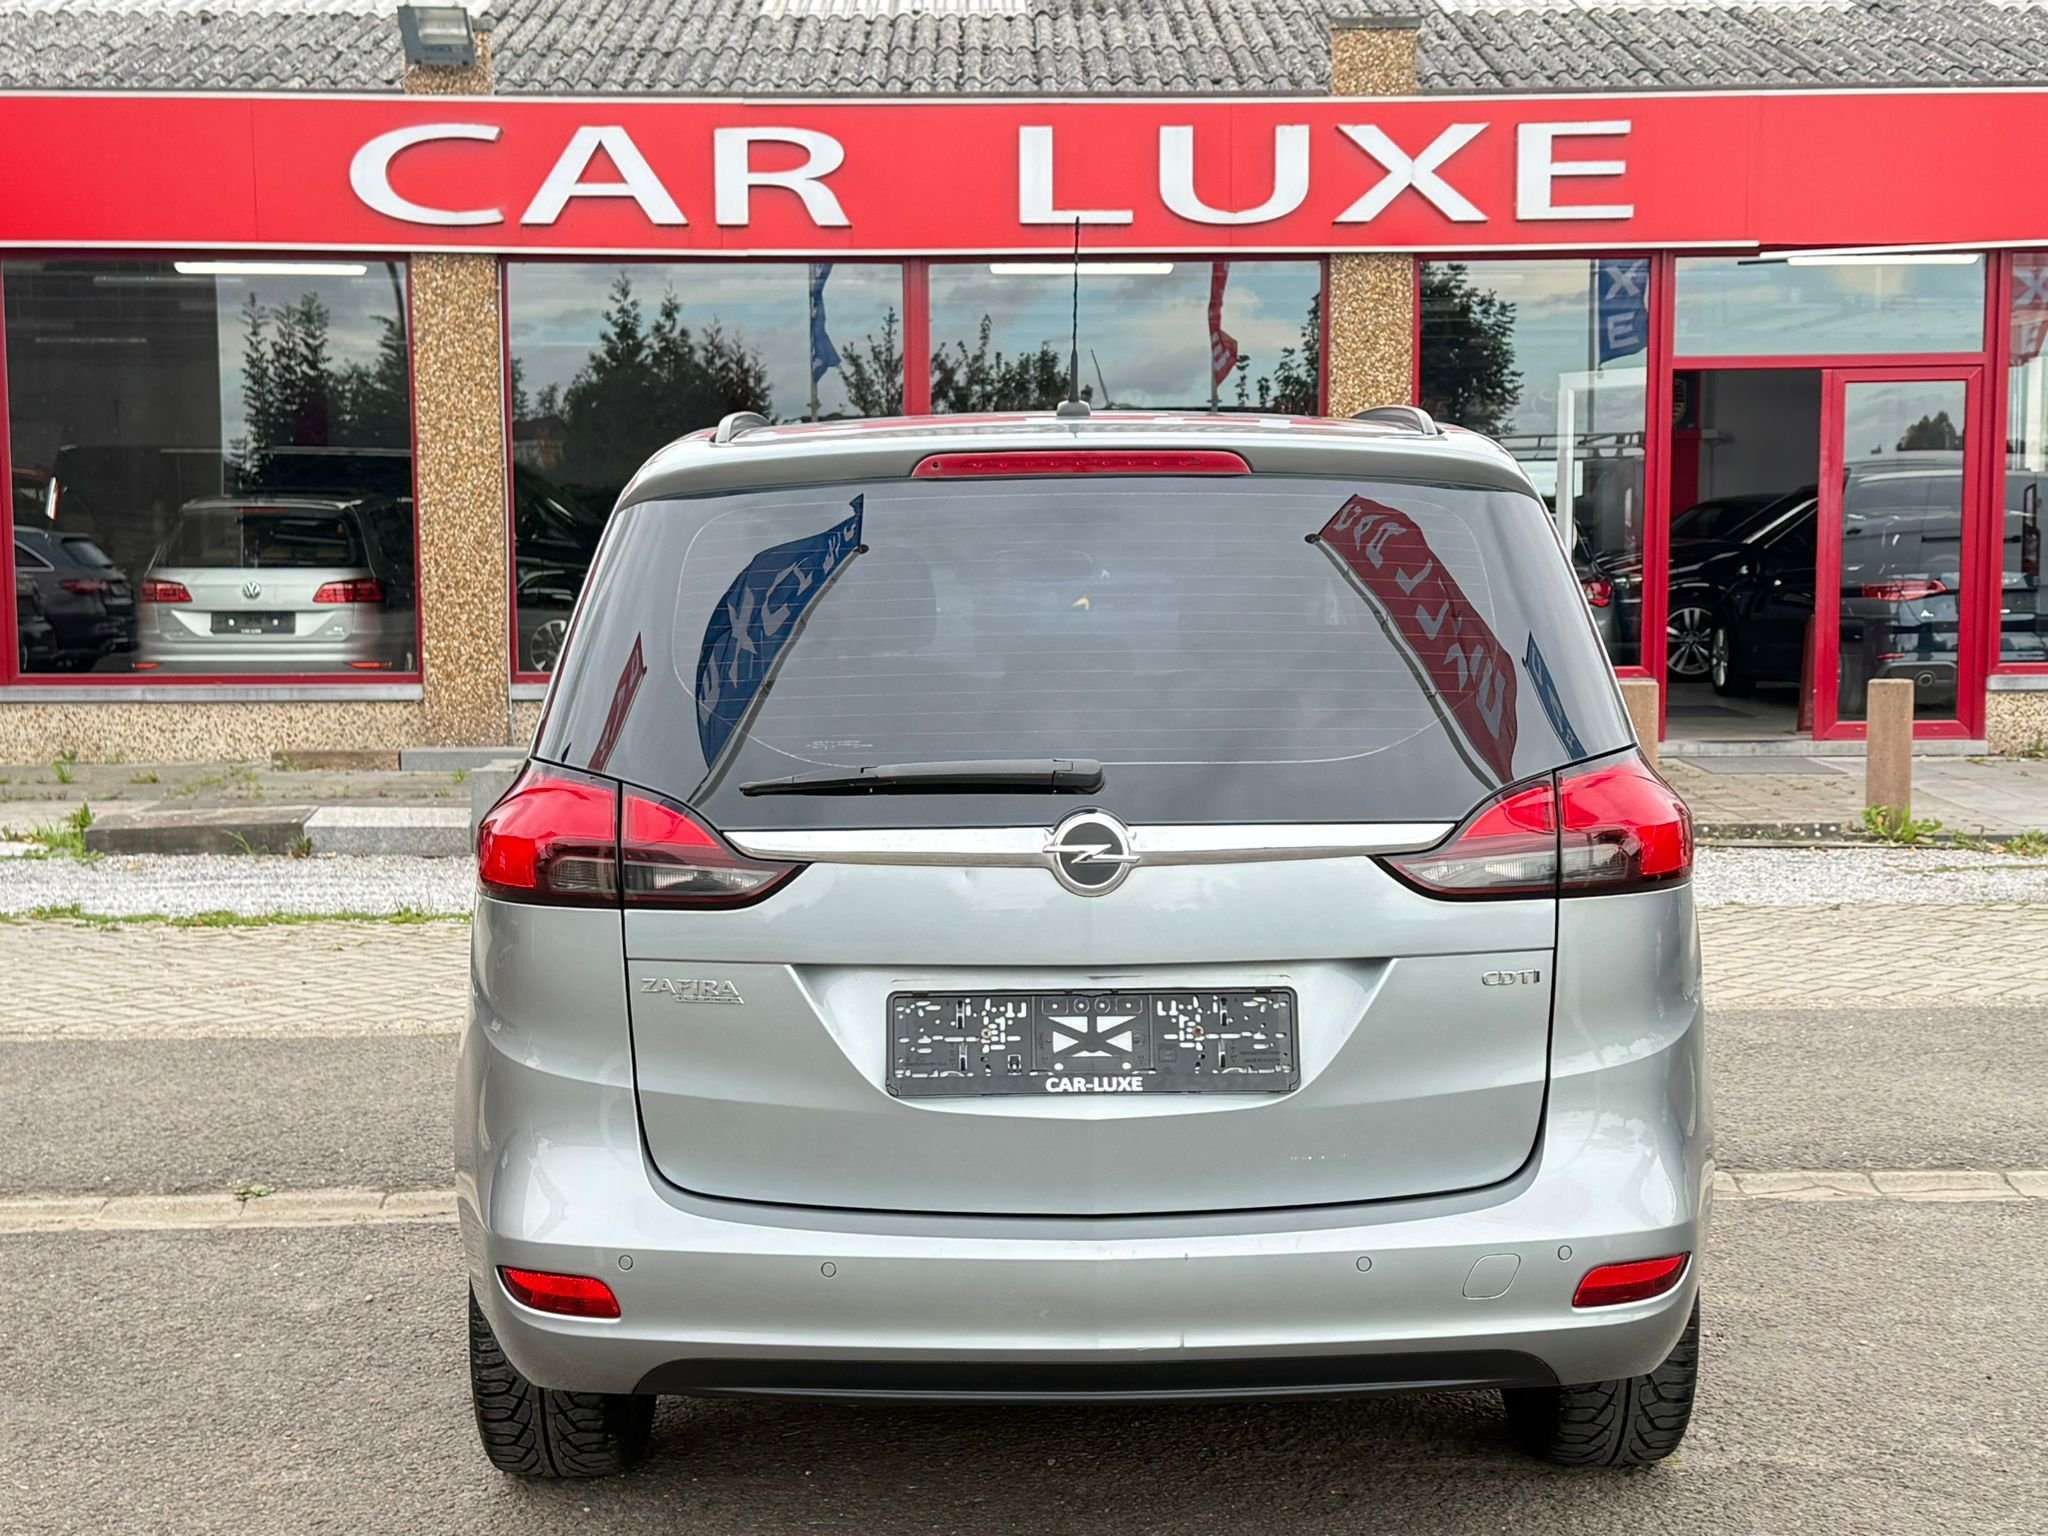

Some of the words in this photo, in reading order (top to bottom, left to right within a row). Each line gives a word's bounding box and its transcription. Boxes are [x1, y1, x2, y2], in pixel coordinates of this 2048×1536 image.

[349, 123, 852, 227] CAR
[1019, 120, 1634, 224] LUXE
[1482, 969, 1541, 985] CDTI
[640, 977, 740, 996] ZAFIRA
[1045, 1076, 1144, 1093] CAR-LUXE
